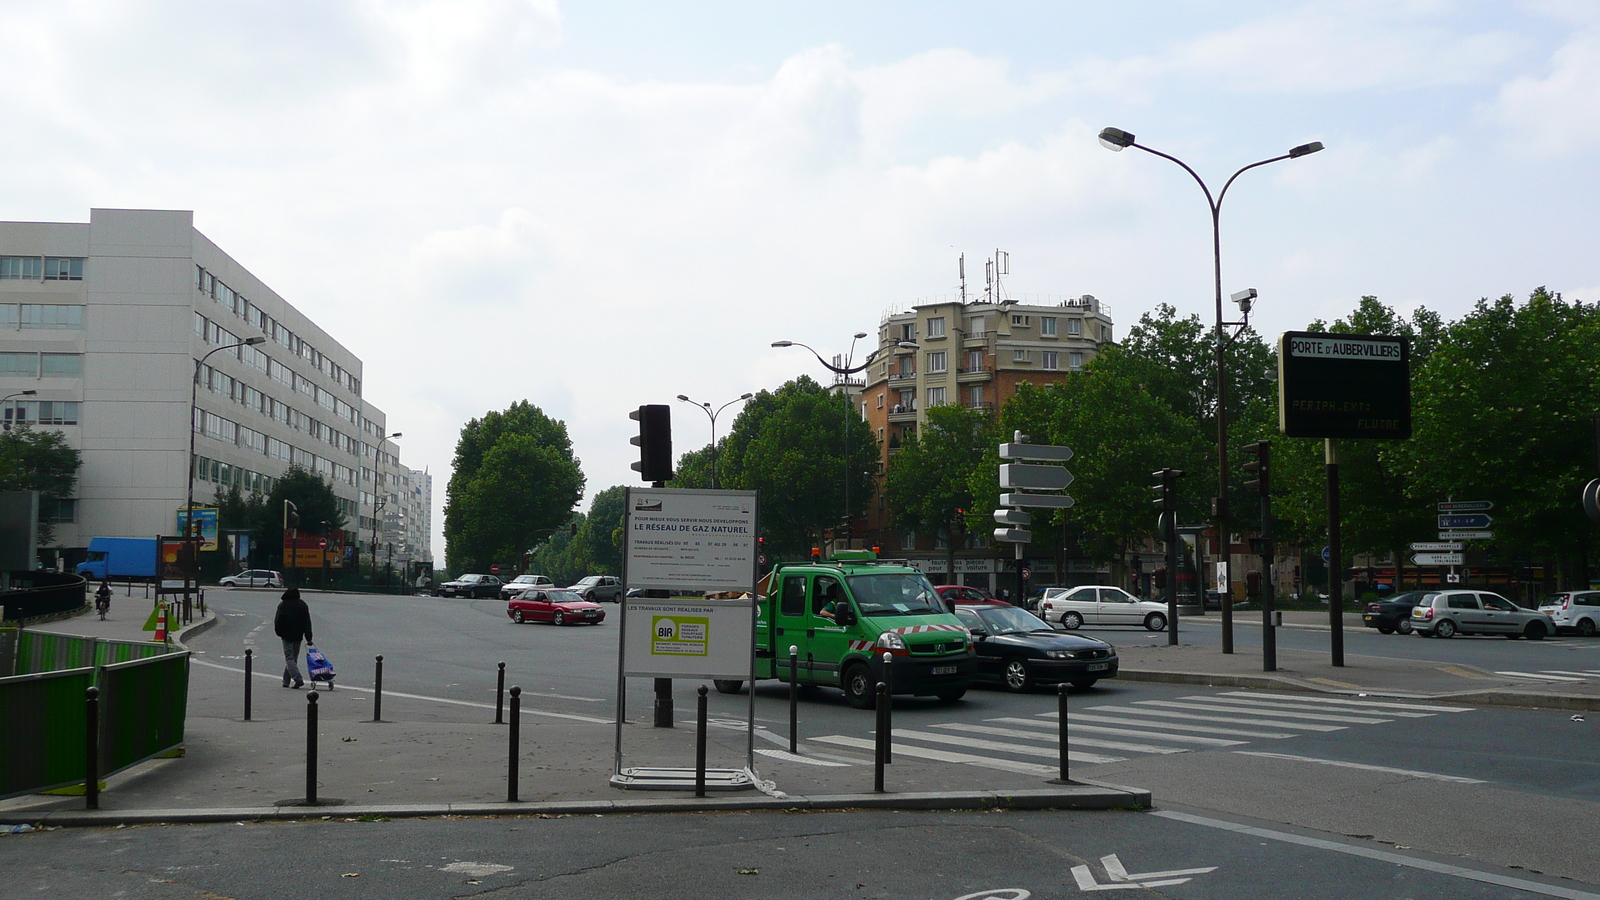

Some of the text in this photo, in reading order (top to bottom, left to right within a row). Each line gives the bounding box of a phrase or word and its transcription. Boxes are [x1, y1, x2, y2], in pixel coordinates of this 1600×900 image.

[1292, 341, 1323, 354] PORTE
[1357, 419, 1400, 429] FLUIDE
[634, 522, 749, 534] LE RÉSEAU DE GAZ NATUREL
